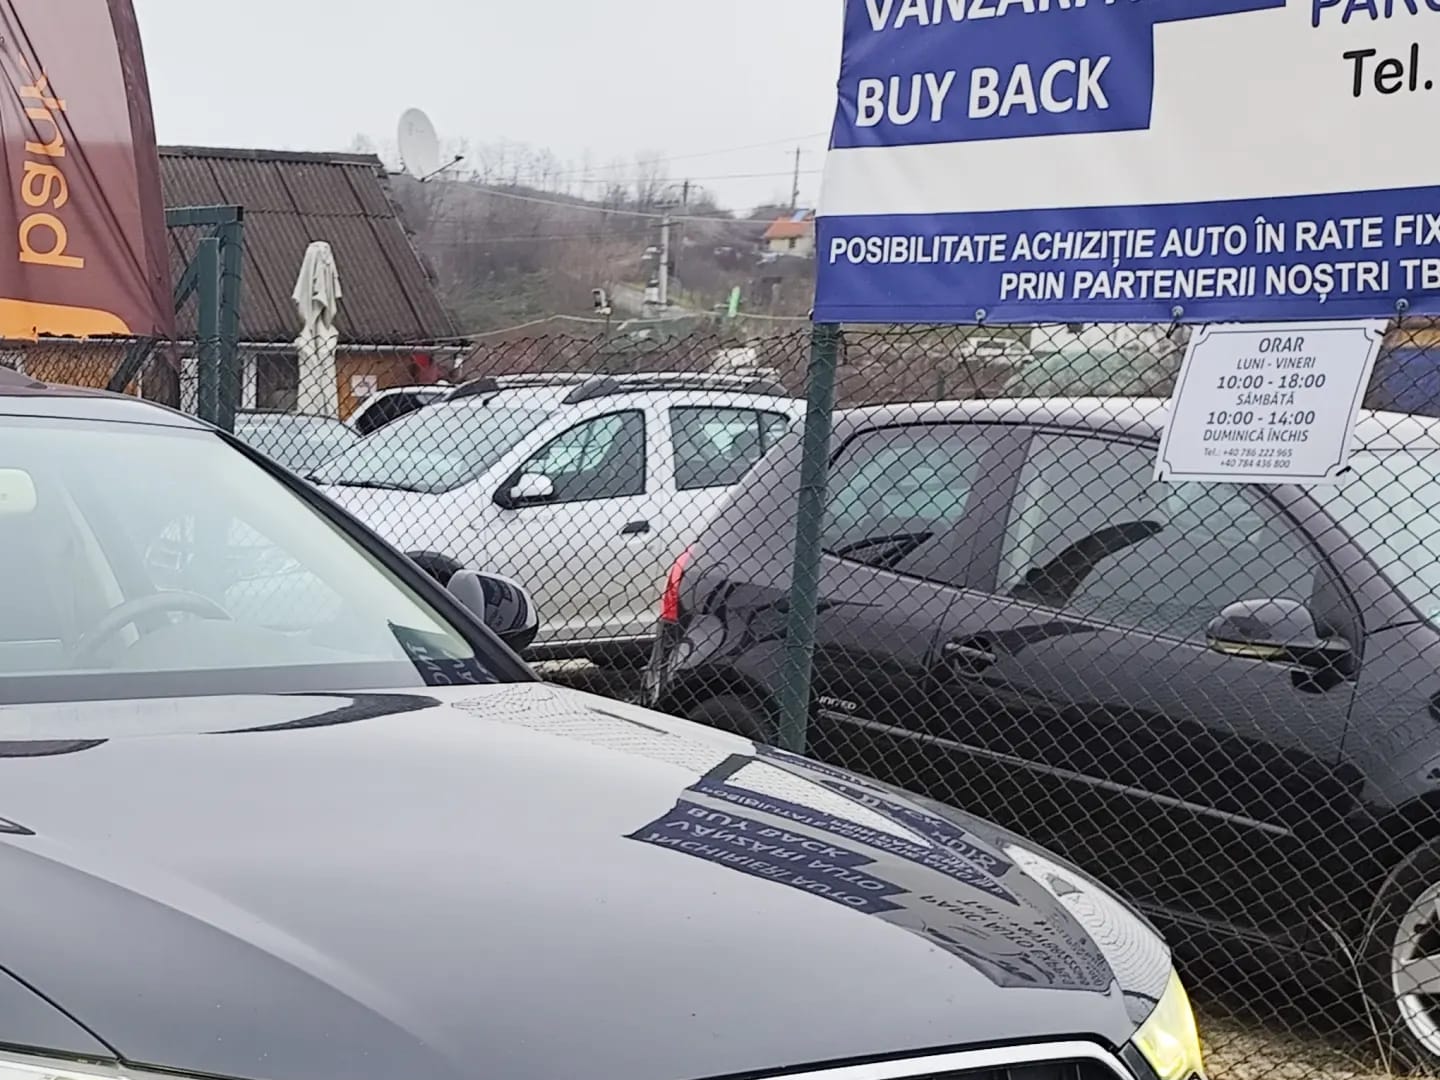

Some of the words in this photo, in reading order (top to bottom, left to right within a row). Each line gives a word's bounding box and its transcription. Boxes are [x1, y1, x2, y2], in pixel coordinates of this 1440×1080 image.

[1343, 42, 1433, 97] Tel.
[855, 72, 955, 127] BUY
[968, 56, 1111, 119] BACK
[829, 234, 1007, 264] POSIBILITATE
[1011, 229, 1156, 267] ACHIZIȚIE
[1160, 224, 1248, 258] AUTO
[1254, 216, 1285, 254] ÎN
[1295, 217, 1384, 252] RATE
[1000, 271, 1065, 301] PRIN
[1072, 266, 1256, 300] PARTENERII
[1265, 259, 1389, 303] NOȘTRI
[1400, 258, 1440, 291] TB
[1258, 336, 1305, 353] ORAR
[1236, 357, 1265, 370] LUNI
[1276, 356, 1316, 369] VINERI
[1216, 375, 1264, 390] 10:00
[1277, 373, 1326, 389] 18:00
[1206, 411, 1254, 425] 10:00
[1268, 410, 1316, 426] 14:00
